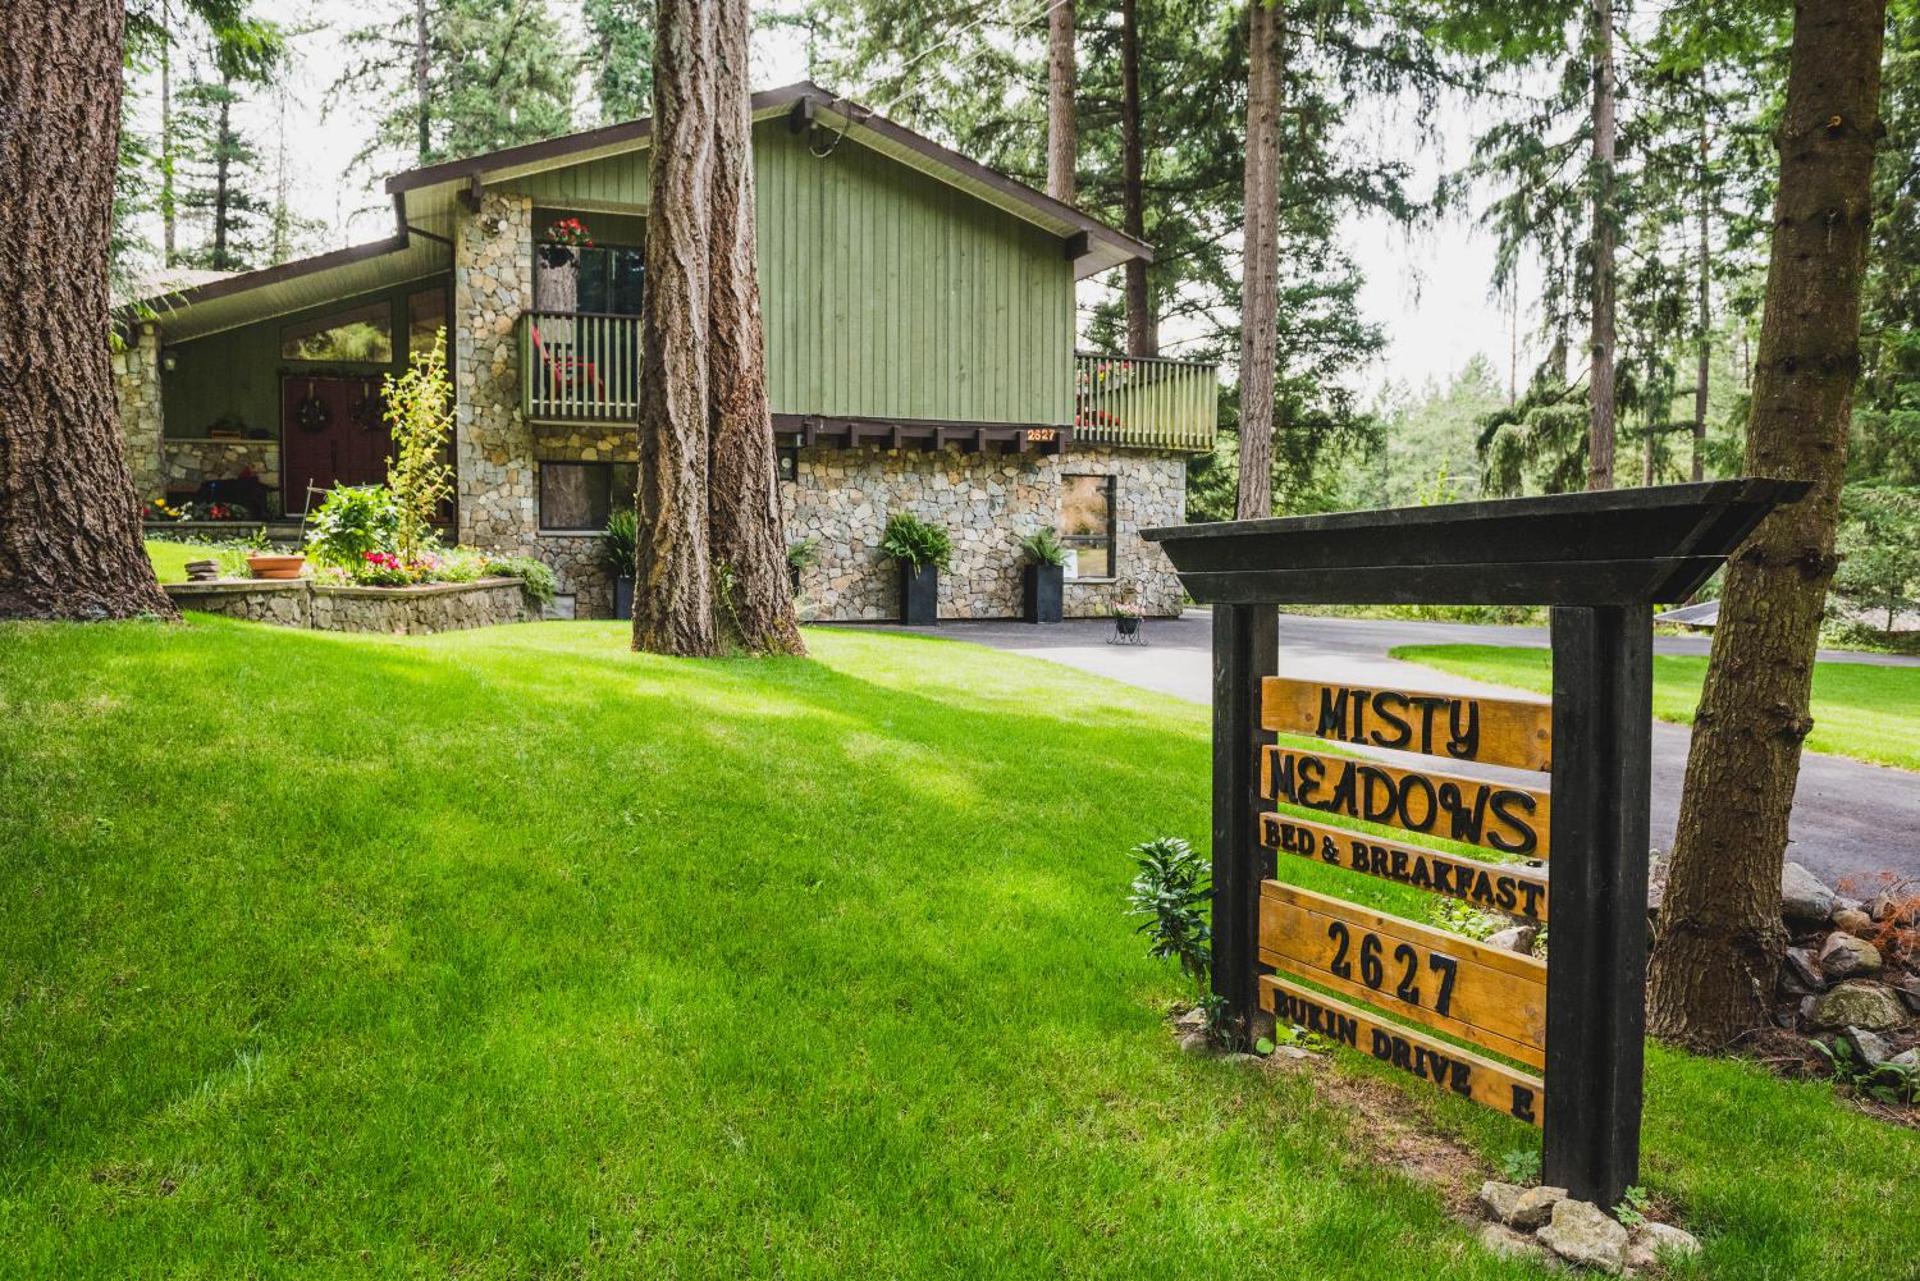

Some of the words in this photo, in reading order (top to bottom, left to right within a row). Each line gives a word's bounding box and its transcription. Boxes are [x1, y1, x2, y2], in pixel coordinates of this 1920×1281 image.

[1027, 429, 1056, 441] 2627
[1315, 687, 1480, 761] MISTY
[1269, 749, 1538, 855] MEADOWS
[1264, 818, 1316, 856] BED
[1321, 834, 1341, 864] &
[1351, 840, 1546, 918] BREAKFAST
[1328, 920, 1458, 1018] 2627
[1371, 1027, 1473, 1098] DRIVE
